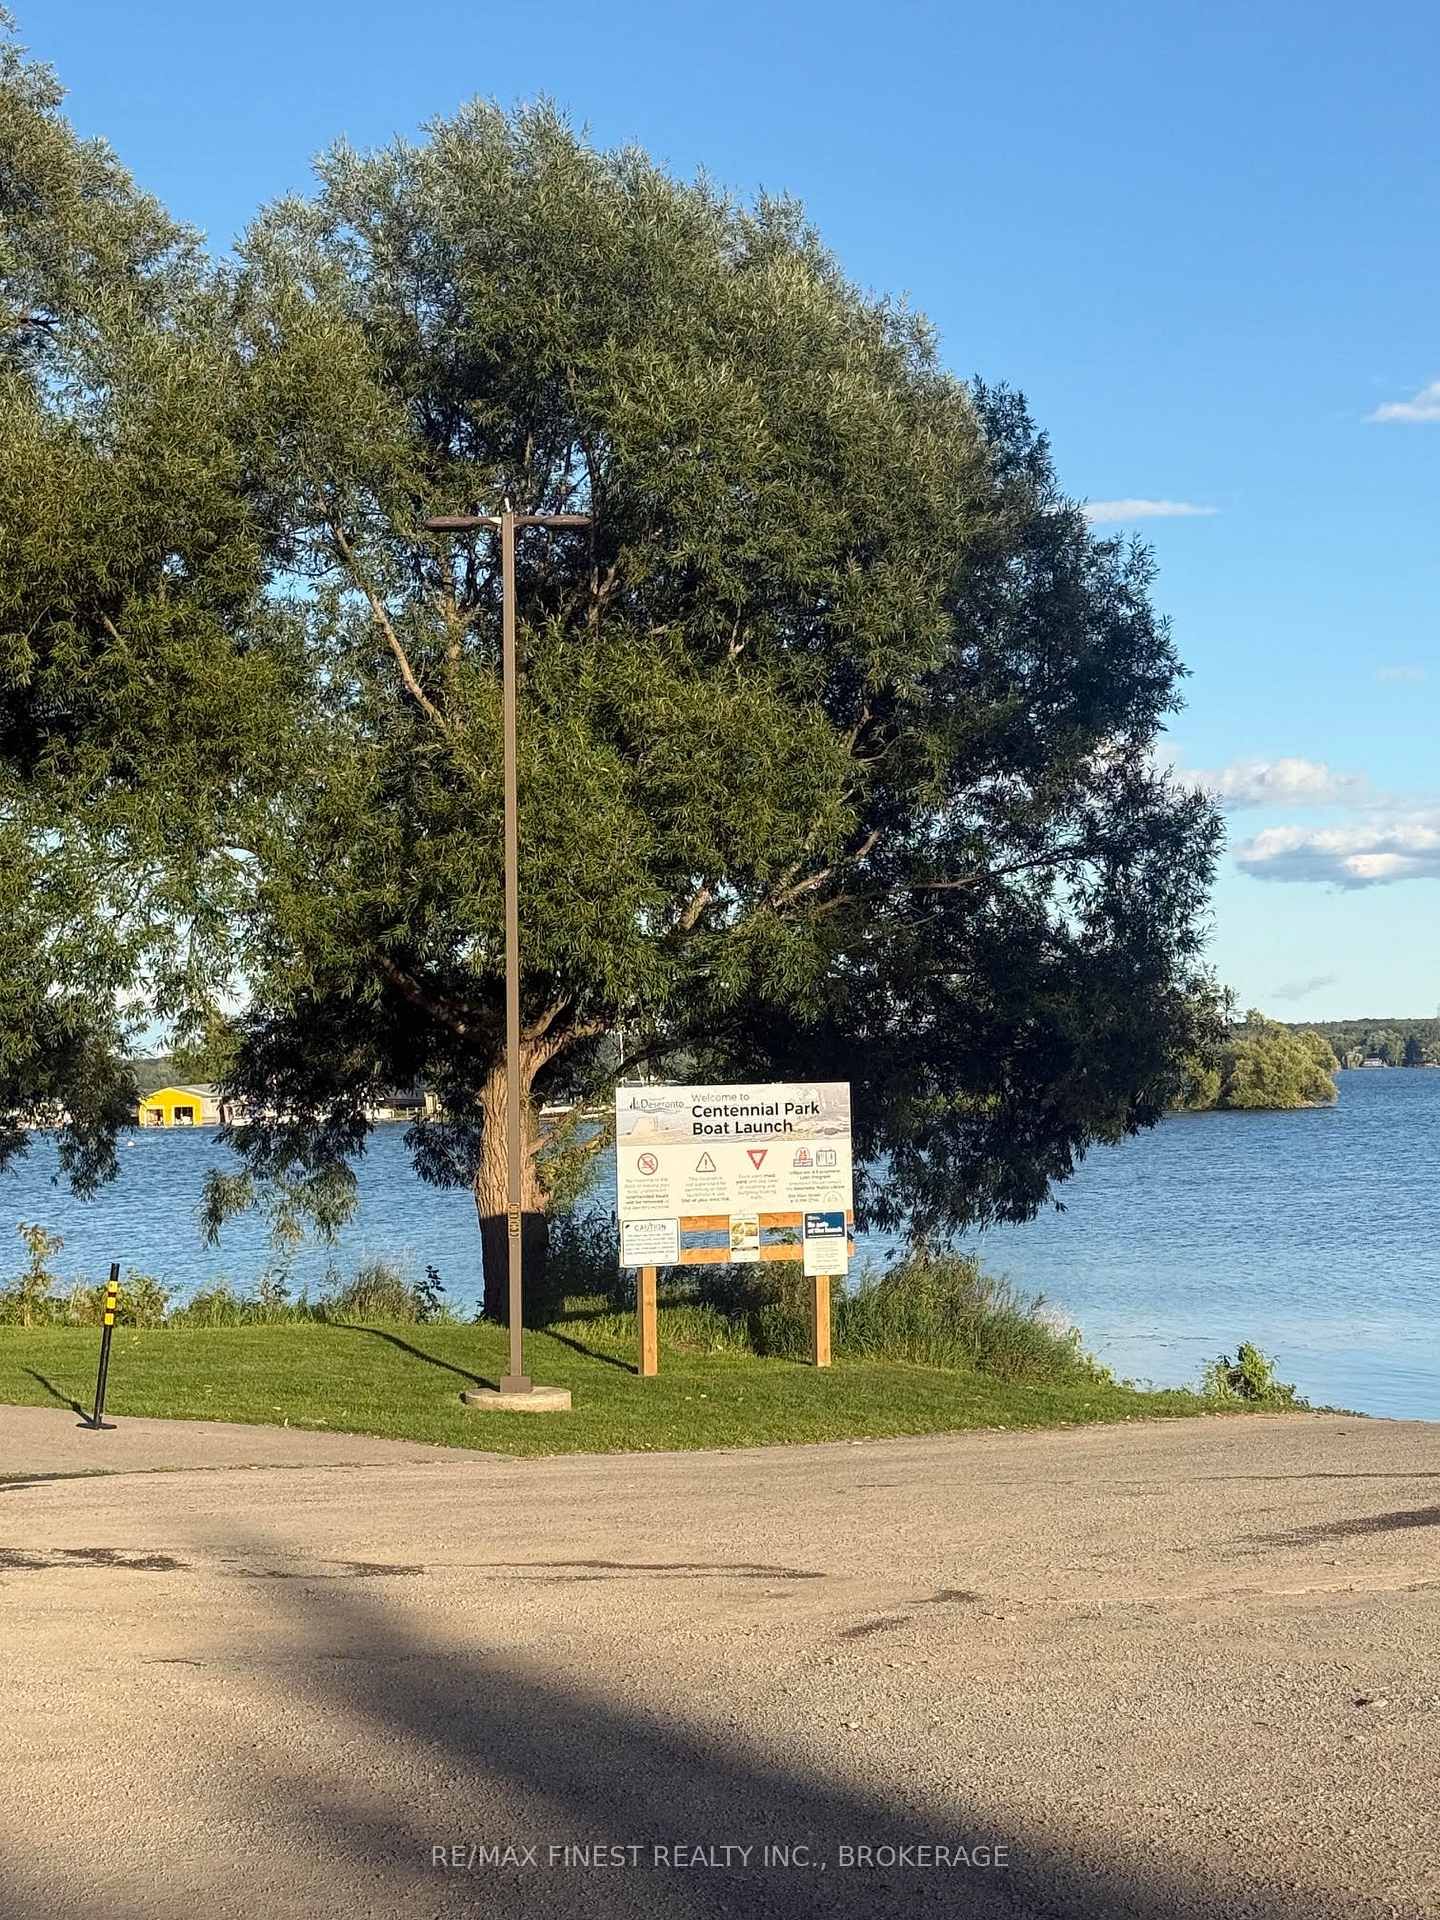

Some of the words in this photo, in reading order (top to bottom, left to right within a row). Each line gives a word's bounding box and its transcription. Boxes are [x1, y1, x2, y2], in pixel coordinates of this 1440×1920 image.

[691, 1093, 737, 1102] Welcome
[739, 1093, 750, 1101] to
[691, 1103, 779, 1117] Centennial
[784, 1101, 820, 1115] Park
[693, 1122, 730, 1135] Boat
[735, 1120, 793, 1134] Launch
